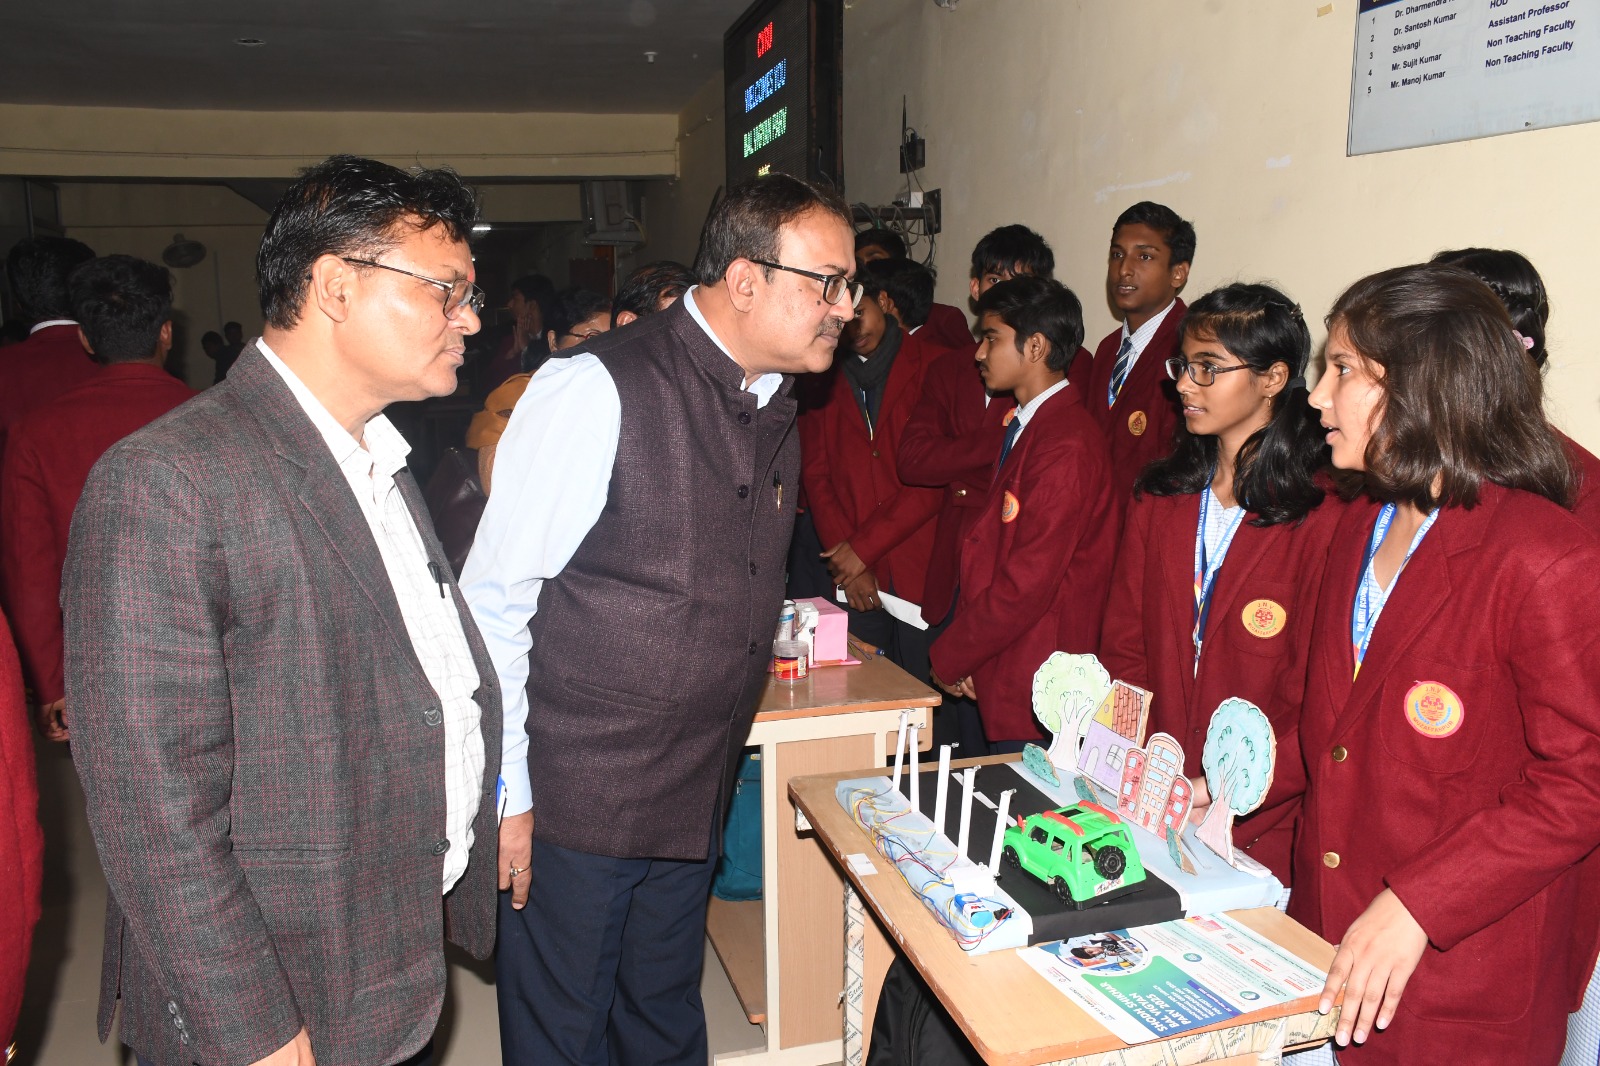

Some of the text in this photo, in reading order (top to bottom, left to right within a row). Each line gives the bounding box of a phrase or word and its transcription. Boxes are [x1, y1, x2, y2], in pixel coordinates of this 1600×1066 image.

[1394, 12, 1457, 36] Dr. Santosh Kumar
[1395, 10, 1404, 18] Dr.
[1488, 0, 1570, 28] Assistant Professor
[1486, 18, 1576, 49] Non Teaching Faculty
[1392, 40, 1421, 54] Shivangi
[1485, 40, 1574, 68] Non Teaching Faculty
[1391, 53, 1442, 71] Mr. Sujit Kumar
[1390, 70, 1446, 89] Mr. Manoj Kumar
[1097, 981, 1138, 1007] SHIKHAR
[1127, 992, 1180, 1028] BAL VIGYAN
[1132, 1007, 1169, 1031] SHODH
[1144, 993, 1192, 1024] PARV 2025
